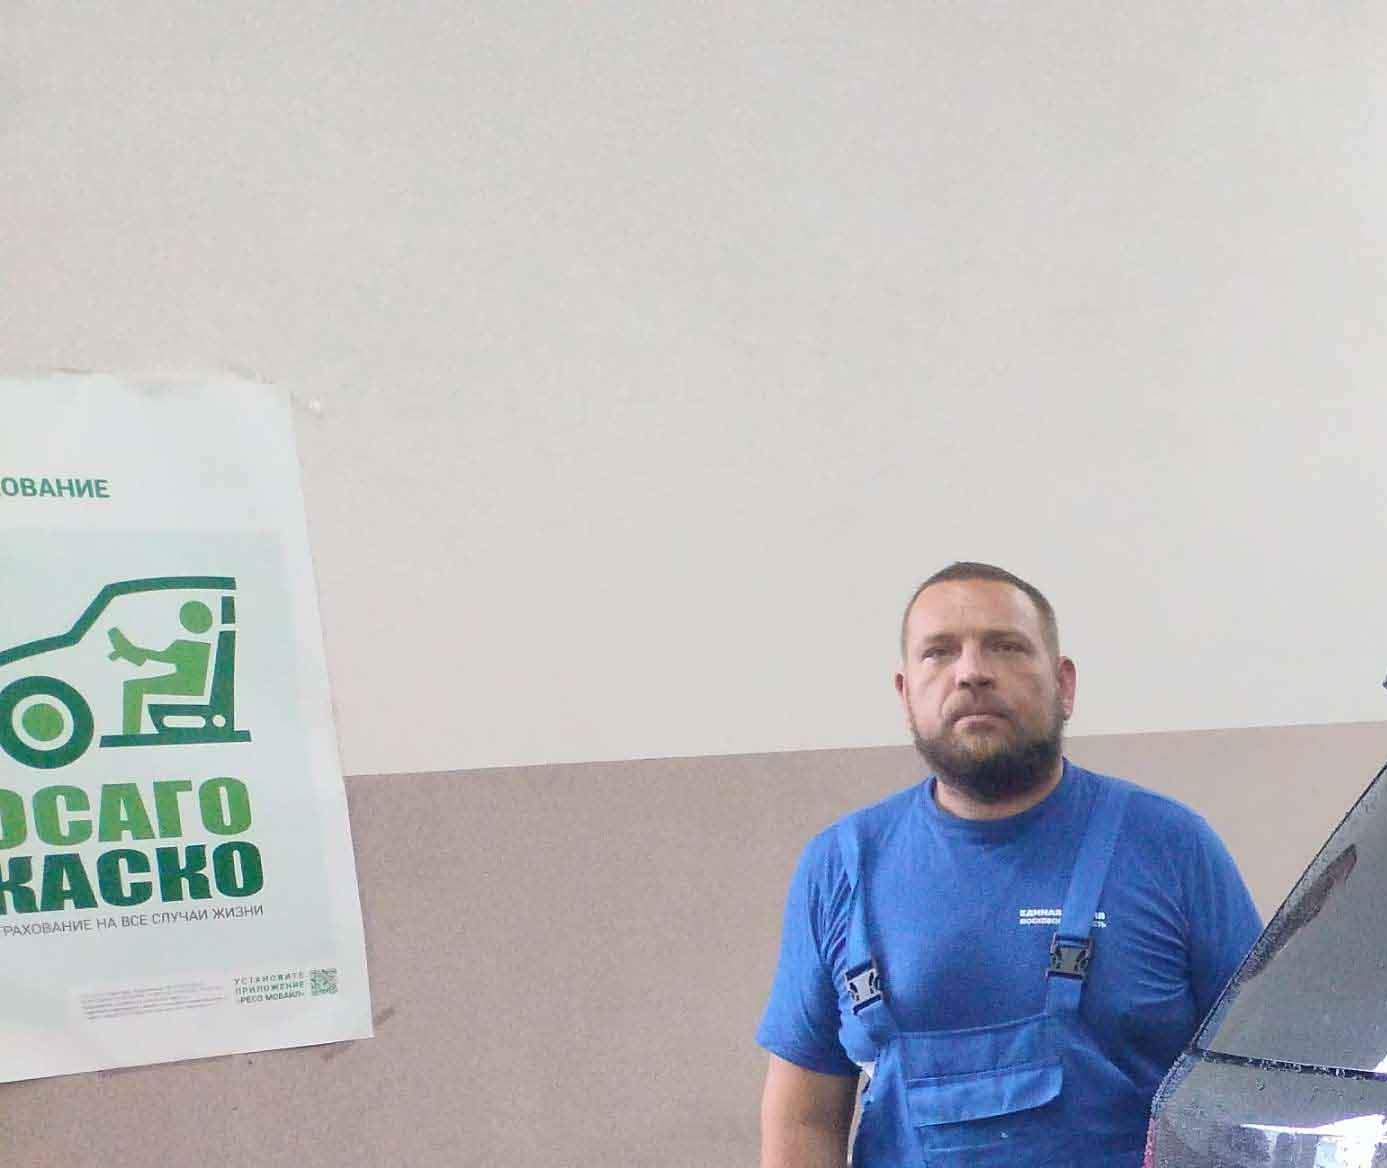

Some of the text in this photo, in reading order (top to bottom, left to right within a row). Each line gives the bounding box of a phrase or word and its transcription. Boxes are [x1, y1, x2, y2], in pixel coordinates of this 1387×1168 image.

[0, 477, 112, 498] ОВАНИЕ
[0, 841, 264, 916] КАСКО
[0, 919, 94, 937] РАХОВАНИЕ
[96, 917, 117, 930] НА
[121, 914, 148, 928] ВСЕ
[212, 904, 264, 920] ЖИЗНИ
[235, 980, 304, 996] ПРИЛОЖЕНИЕ
